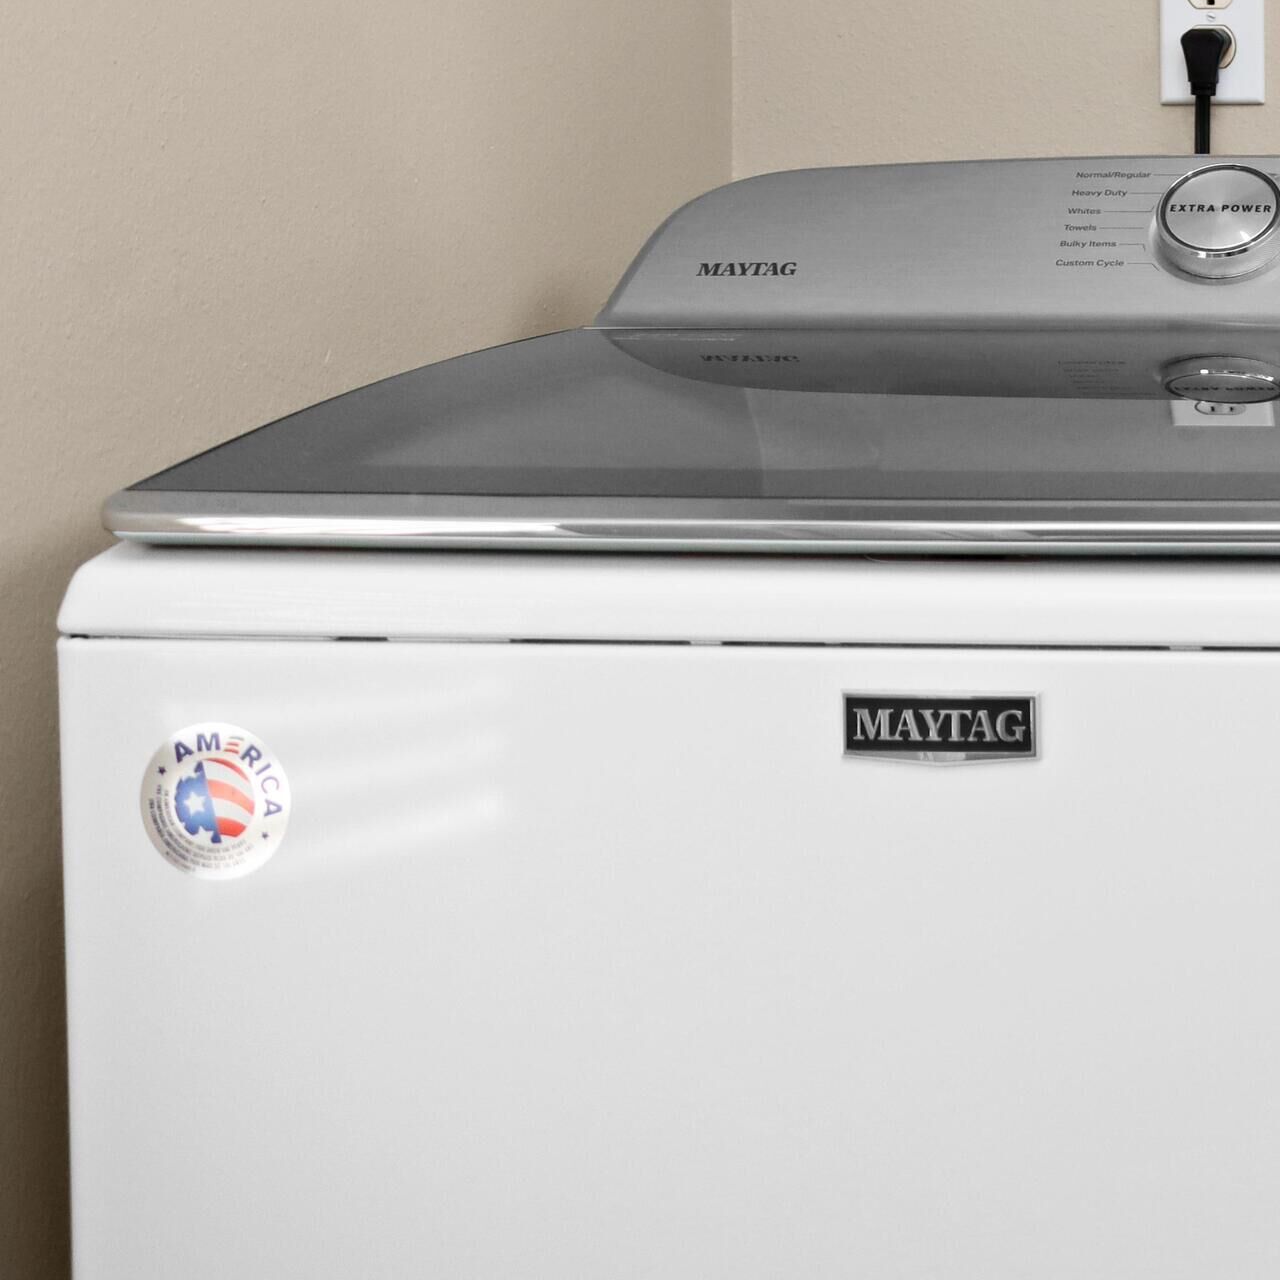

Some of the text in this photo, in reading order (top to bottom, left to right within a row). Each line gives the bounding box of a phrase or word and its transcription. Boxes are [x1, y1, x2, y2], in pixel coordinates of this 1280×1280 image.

[1075, 171, 1152, 180] Normal/Regular
[1072, 189, 1128, 198] Heavy Duty
[1067, 207, 1102, 215] Whites
[1169, 204, 1273, 214] EXTRA POWER
[1064, 223, 1097, 231] Towels
[1060, 240, 1087, 249] Bulky
[1055, 259, 1125, 268] Custom Cycle
[696, 262, 797, 277] MAYTAG
[853, 708, 1026, 742] MAYTAG
[174, 732, 283, 818] AMERICA
